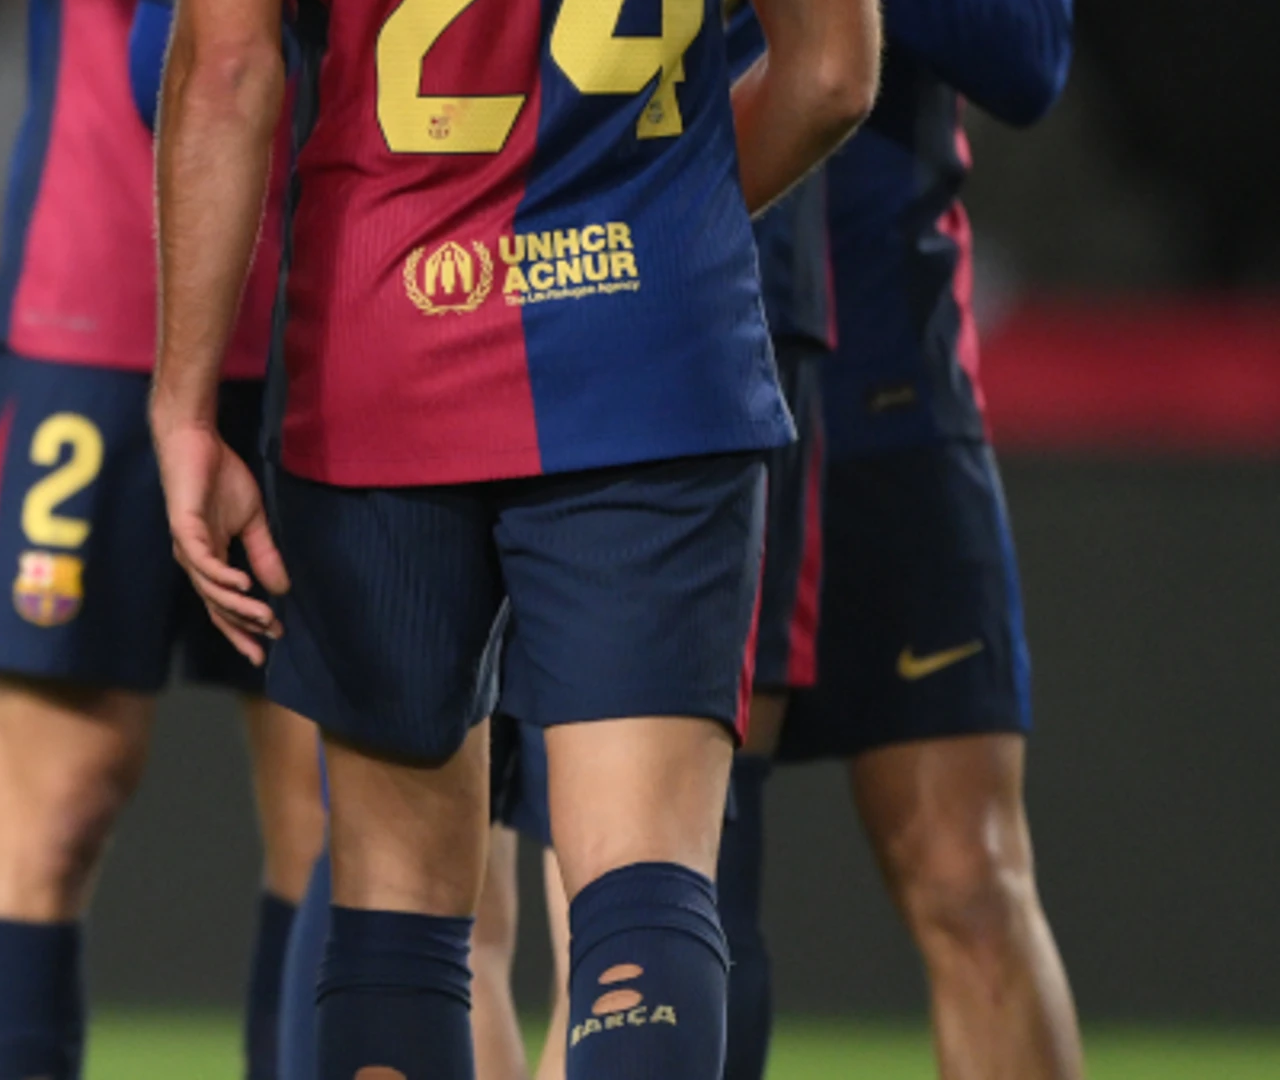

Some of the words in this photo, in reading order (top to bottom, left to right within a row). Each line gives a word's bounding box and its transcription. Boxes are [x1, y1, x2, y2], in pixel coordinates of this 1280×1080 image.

[498, 222, 634, 263] UNHCR
[502, 251, 638, 294] ACNUR
[20, 410, 105, 549] 2
